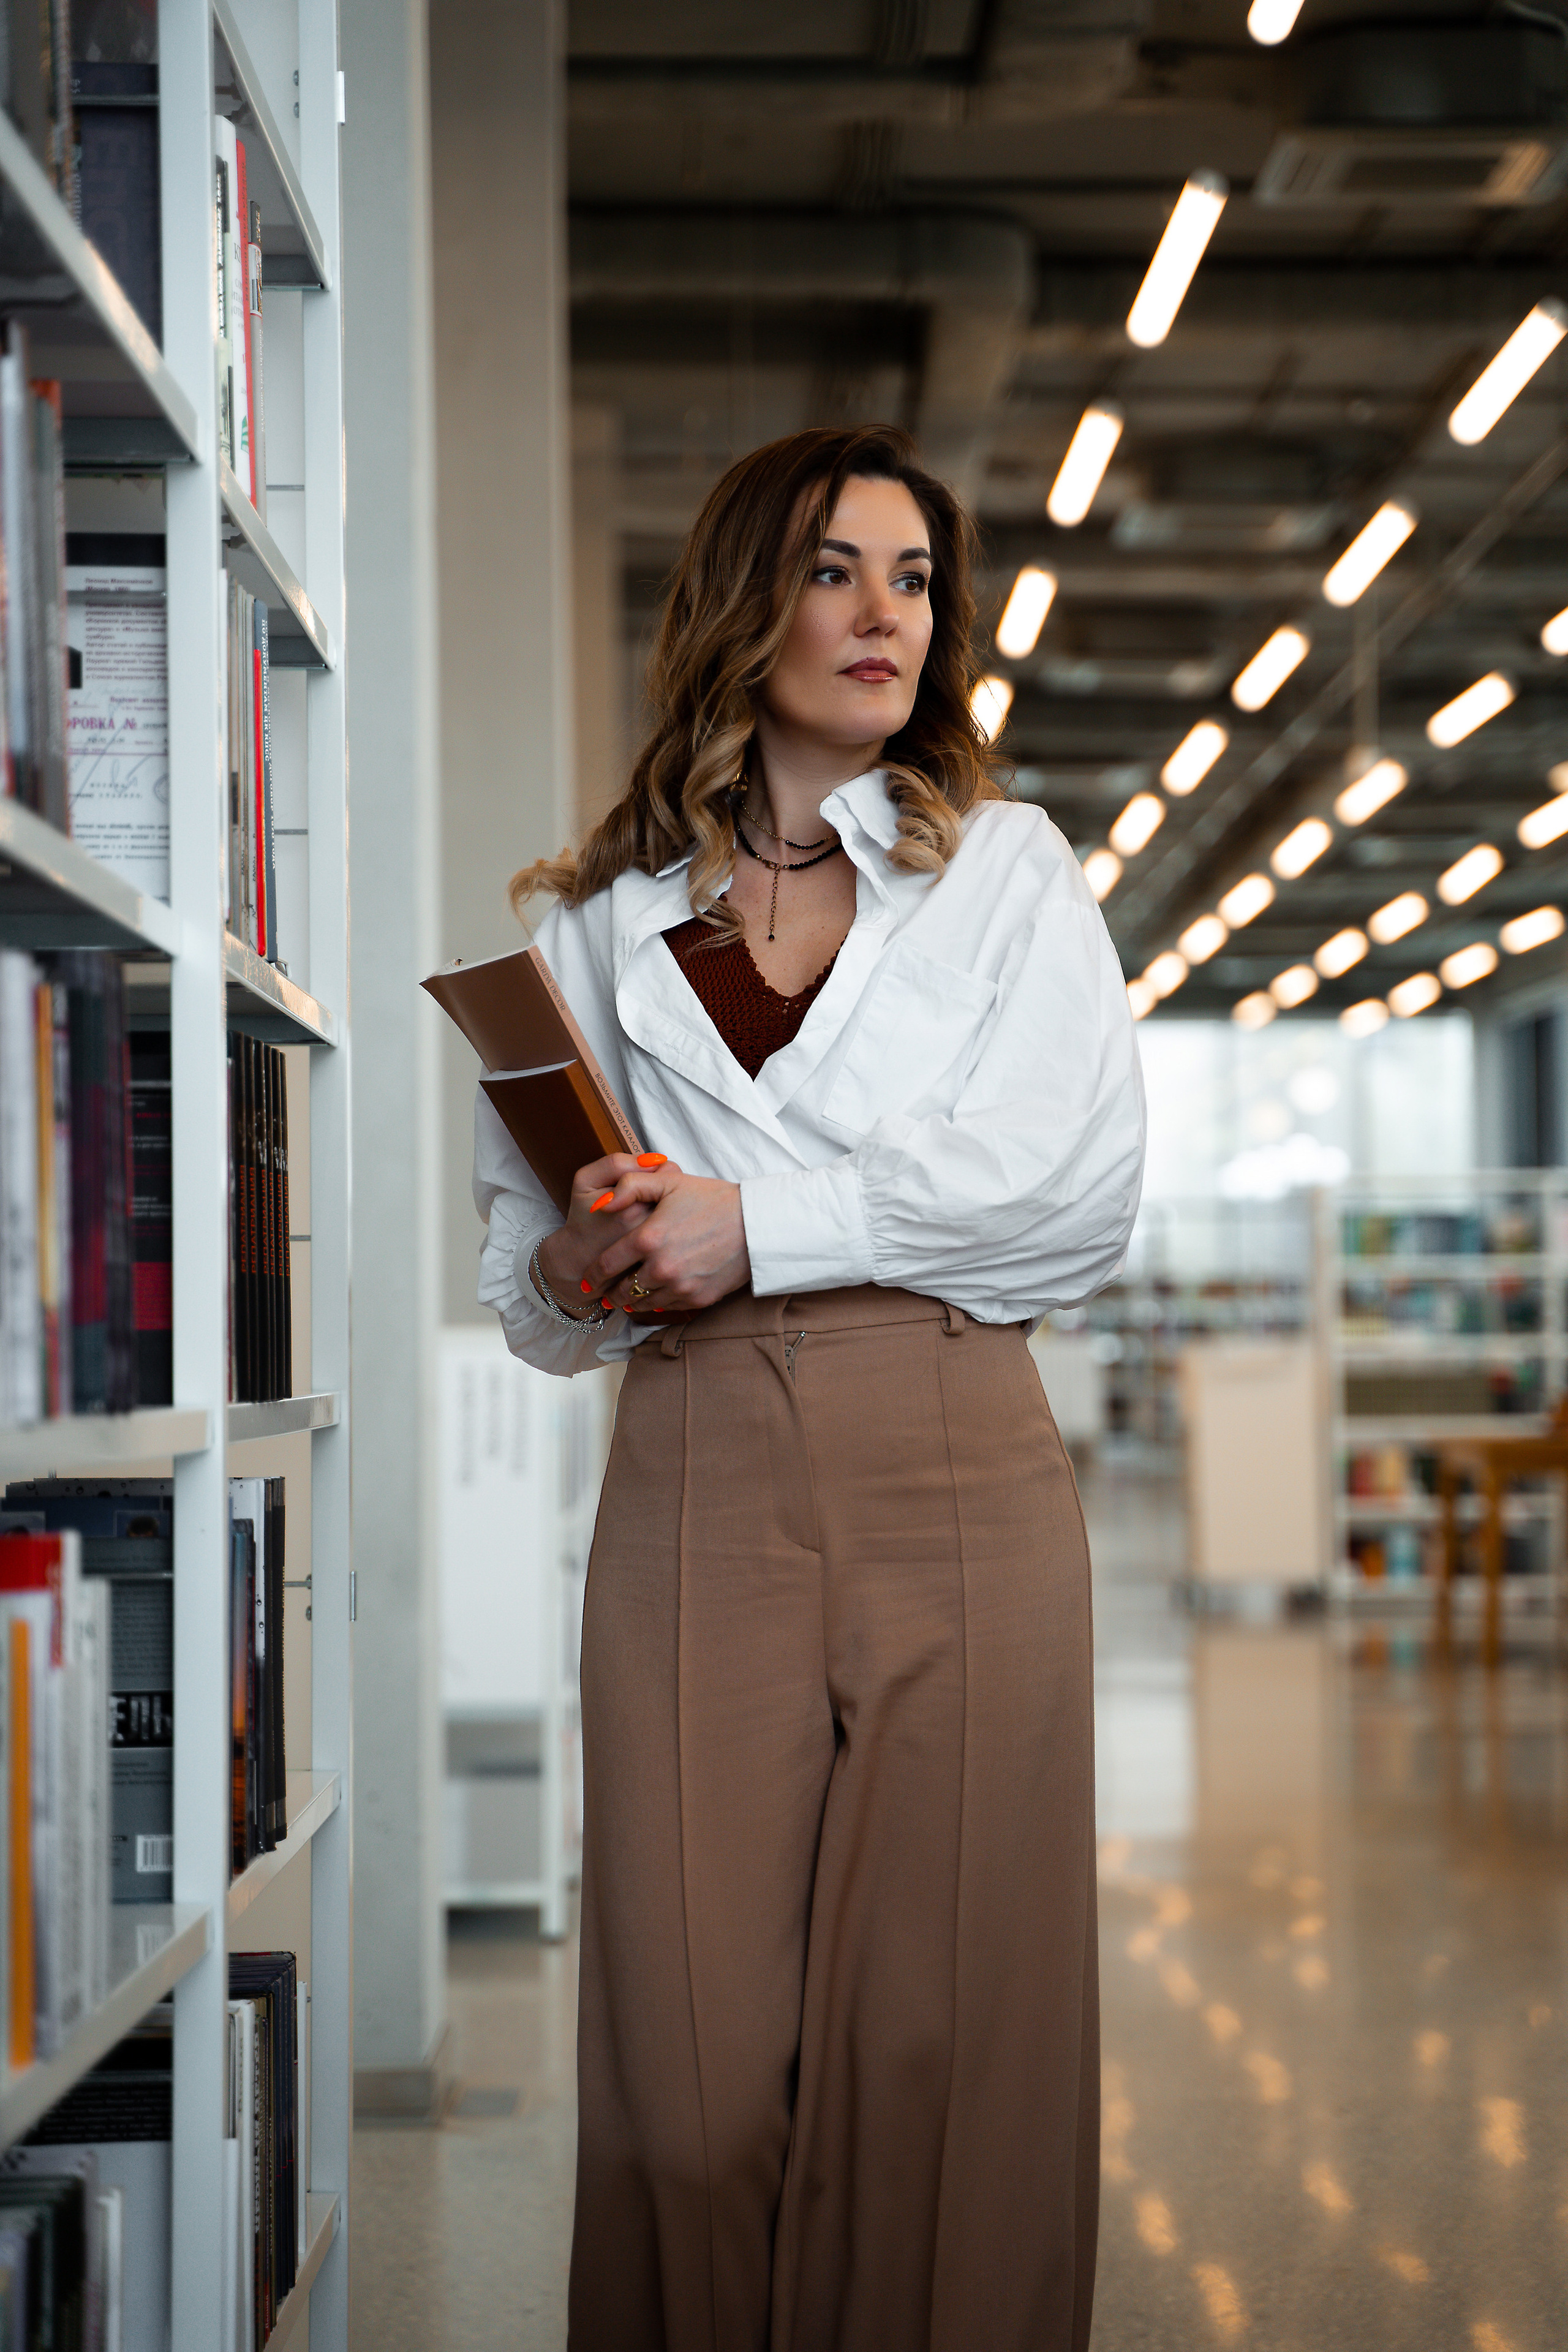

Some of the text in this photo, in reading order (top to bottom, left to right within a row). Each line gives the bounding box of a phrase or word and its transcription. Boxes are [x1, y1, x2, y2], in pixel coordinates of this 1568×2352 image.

[262, 619, 266, 634] ПО
[263, 715, 268, 730] ЦК
[535, 957, 565, 1011] GARDA DECOR
[595, 1072, 641, 1153] ВОЗЬМИТЕ ЭТОТ КАТАЛОГ
